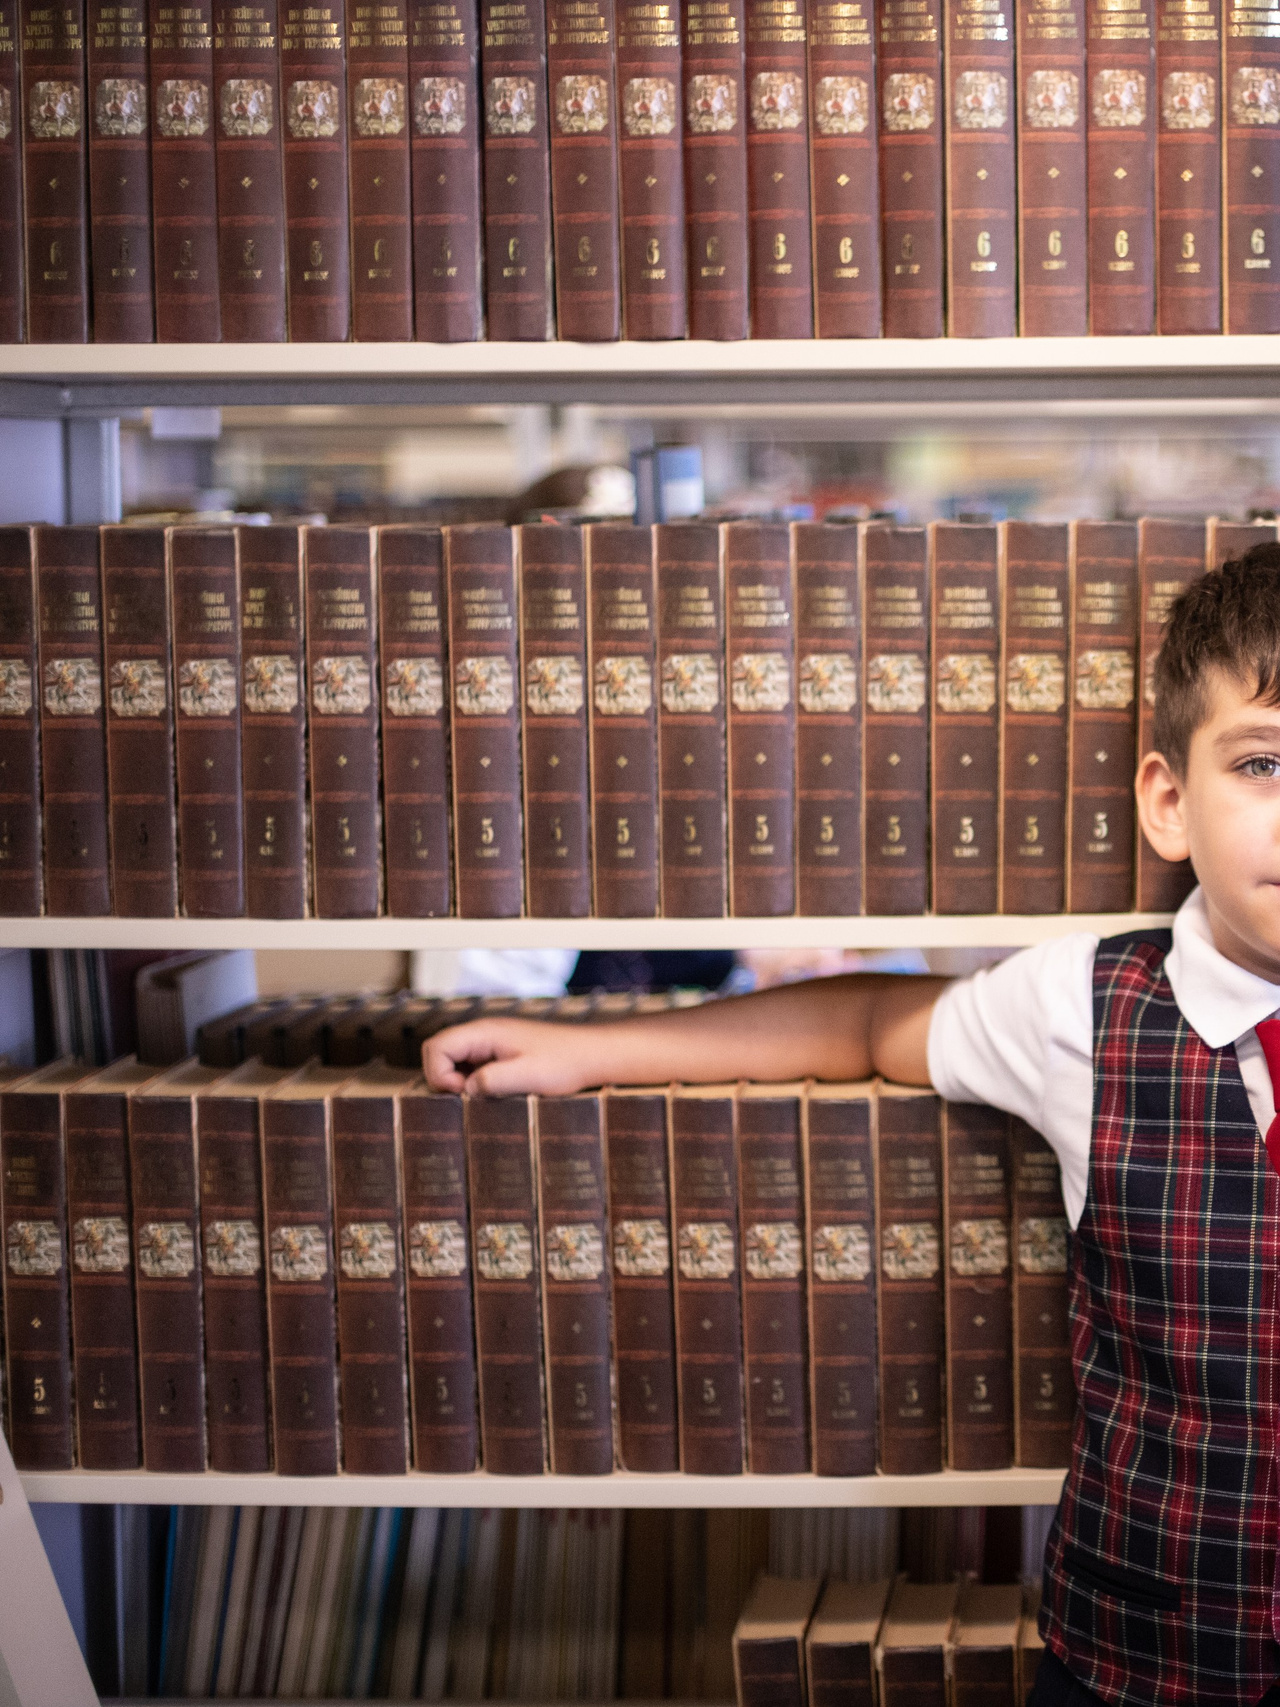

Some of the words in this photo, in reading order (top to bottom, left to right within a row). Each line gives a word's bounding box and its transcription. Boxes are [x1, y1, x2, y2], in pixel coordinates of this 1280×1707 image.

[839, 236, 853, 264] 6
[976, 231, 991, 257] 6
[1048, 230, 1062, 256] 6
[1114, 229, 1129, 258] 6
[1250, 228, 1265, 254] 6
[481, 818, 495, 844] 5
[617, 818, 630, 844] 5
[756, 815, 769, 841] 5
[820, 816, 834, 842] 5
[887, 816, 901, 842] 5
[960, 817, 974, 843] 5
[1025, 816, 1039, 842] 5
[1094, 812, 1108, 839] 5
[33, 1377, 46, 1402] 5
[704, 1378, 717, 1404] 5
[975, 1375, 988, 1399] 5
[1040, 1372, 1054, 1397] 5
